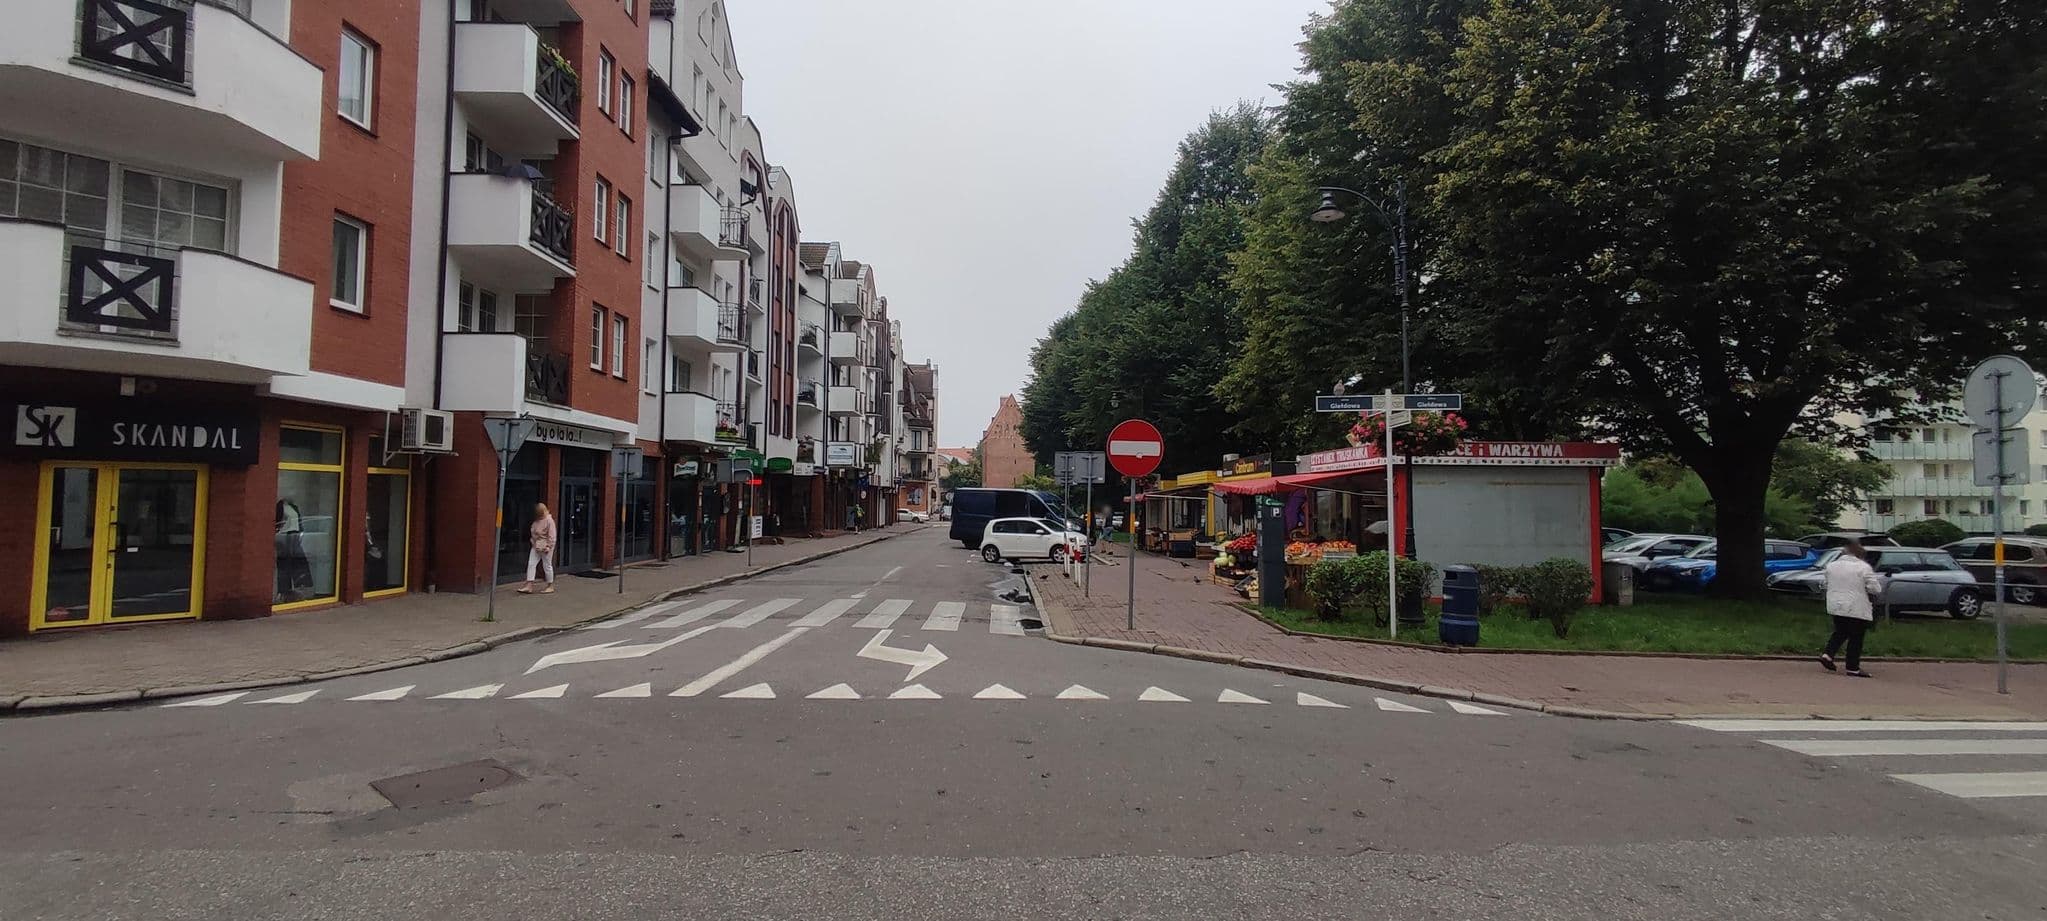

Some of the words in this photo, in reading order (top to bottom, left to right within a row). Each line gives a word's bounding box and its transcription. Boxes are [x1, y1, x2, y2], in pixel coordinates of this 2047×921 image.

[26, 405, 64, 447] SK
[536, 423, 547, 441] by
[549, 428, 555, 439] o
[557, 426, 564, 441] la
[112, 422, 242, 450] SKANDAL
[1478, 443, 1484, 456] i
[1489, 443, 1563, 457] WARZYWA
[1273, 507, 1280, 517] P
